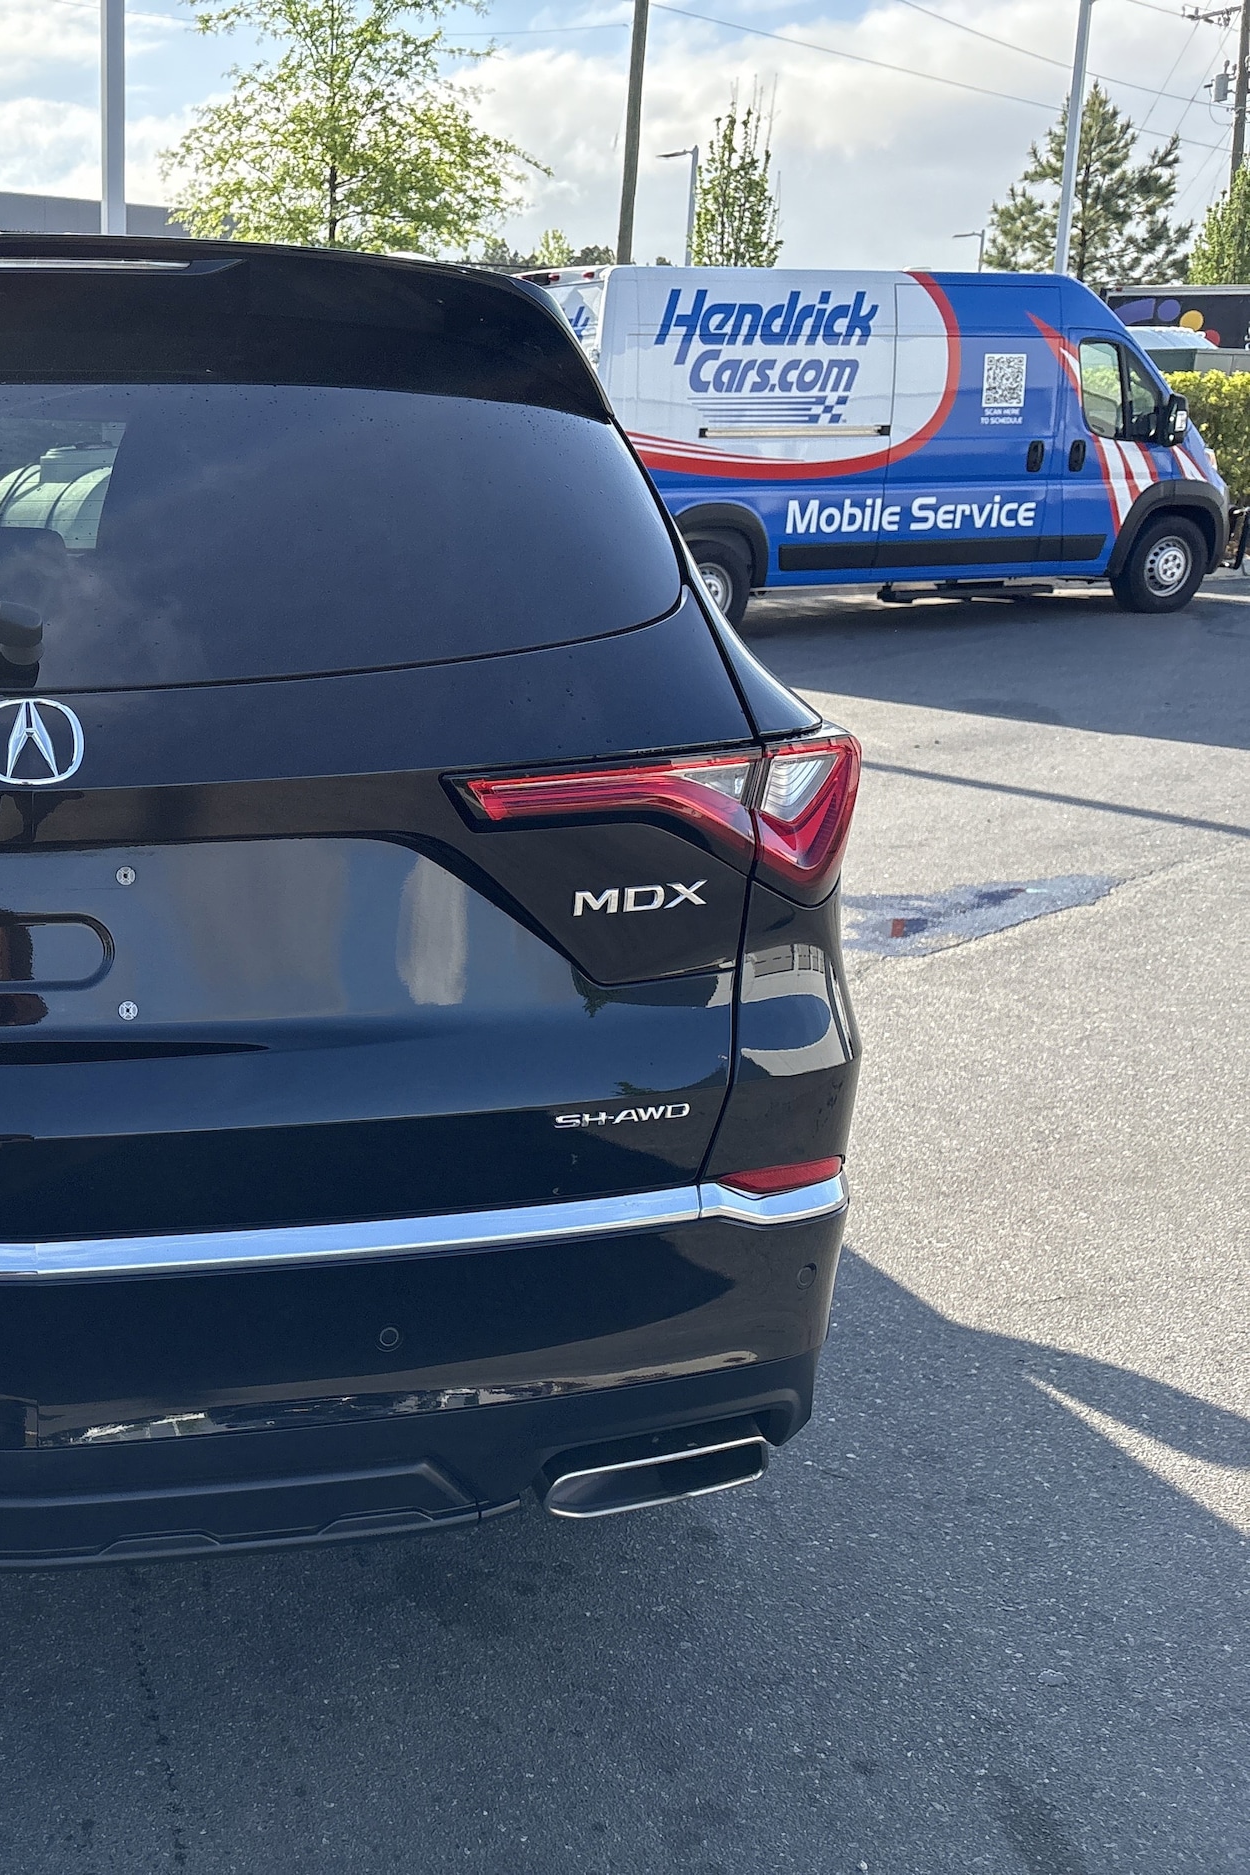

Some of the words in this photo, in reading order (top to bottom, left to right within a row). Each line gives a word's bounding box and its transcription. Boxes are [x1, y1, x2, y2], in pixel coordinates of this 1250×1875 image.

[654, 289, 879, 365] Hendrick
[689, 349, 859, 393] Cars.com
[984, 408, 1002, 416] SCAN
[785, 498, 900, 534] Mobile
[909, 495, 1036, 531] Service
[572, 879, 708, 917] MDX
[554, 1102, 691, 1129] SH-AWD
